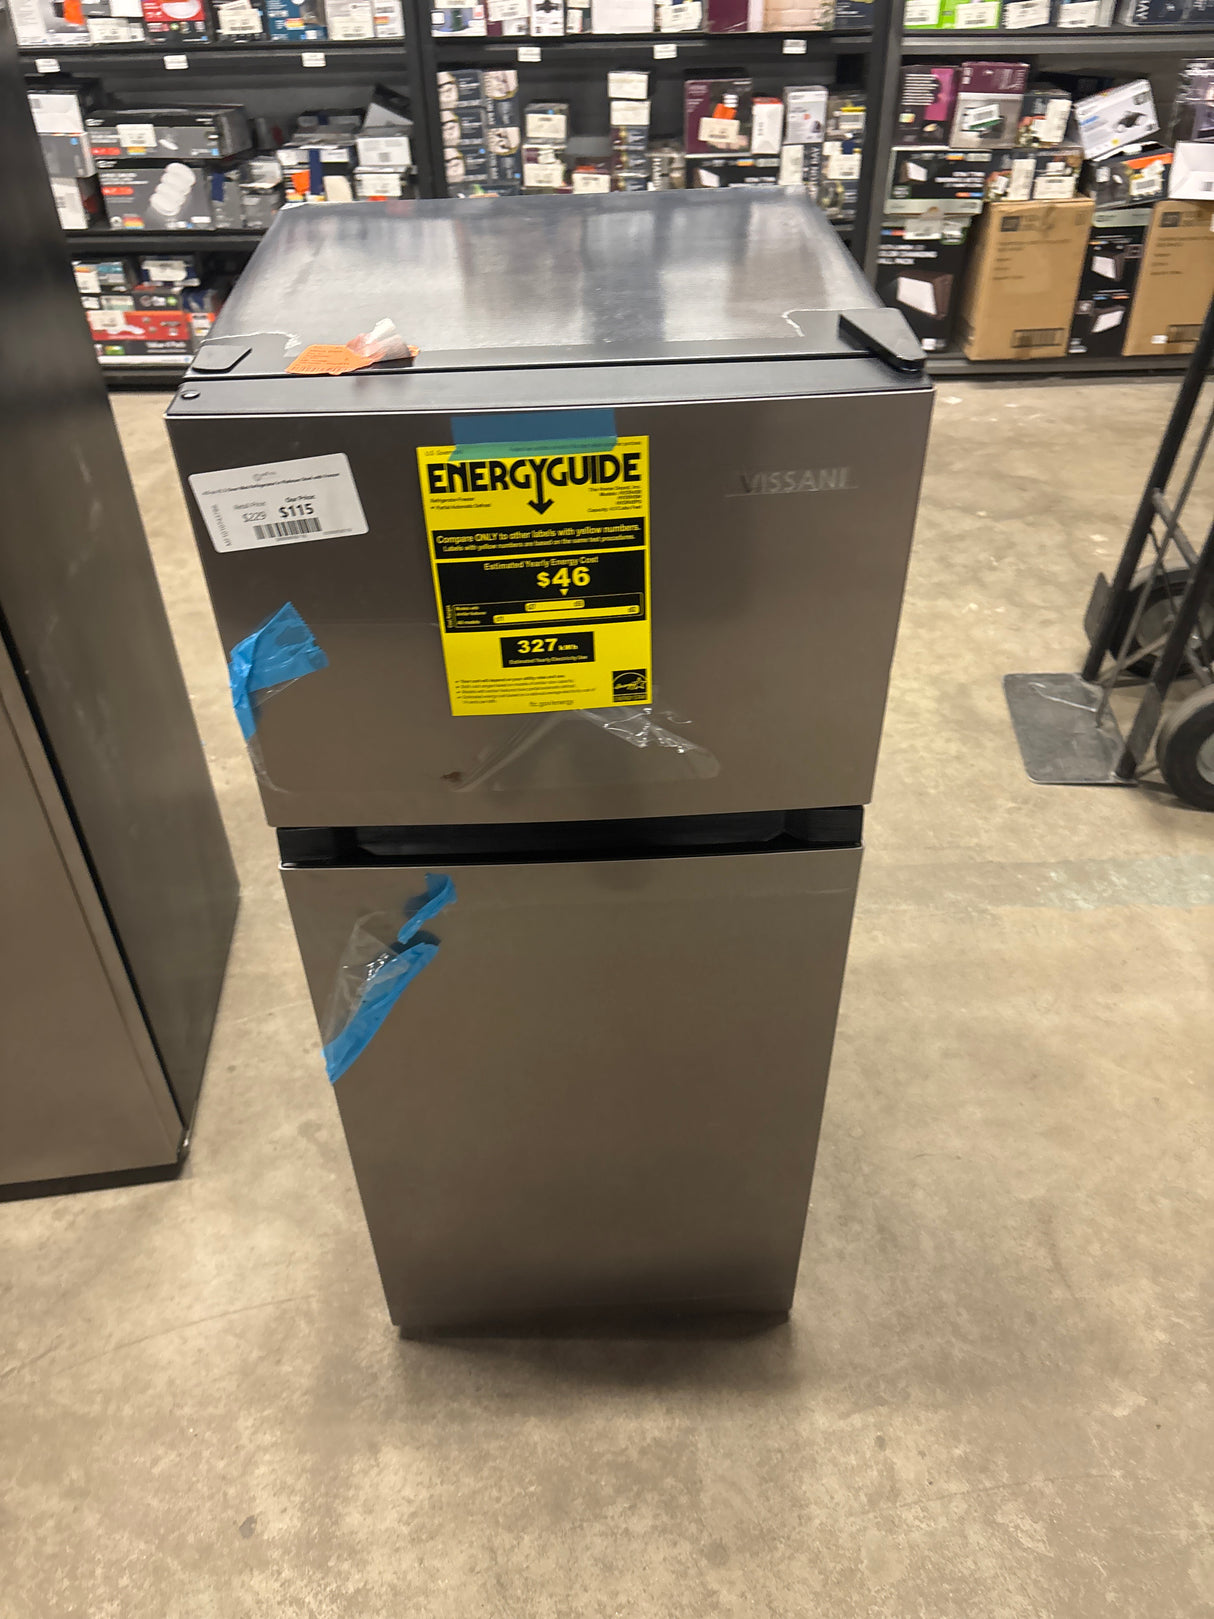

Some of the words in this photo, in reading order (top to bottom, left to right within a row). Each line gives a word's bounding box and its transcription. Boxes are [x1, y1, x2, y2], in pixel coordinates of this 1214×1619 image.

[426, 452, 642, 495] ENERGYGUIDE
[740, 466, 850, 494] VISSANI
[278, 503, 315, 518] $115
[436, 535, 474, 545] Compare
[474, 532, 498, 542] ONLY
[498, 532, 508, 540] to
[509, 530, 531, 540] other
[531, 529, 557, 538] labels
[557, 527, 575, 536] with
[575, 526, 602, 537] yellow
[602, 523, 641, 534] numbers.
[483, 560, 524, 571] Estimated
[525, 558, 549, 569] Yearly
[549, 557, 578, 567] Energy
[579, 556, 599, 564] Cost
[537, 566, 591, 588] $46
[517, 637, 558, 654] 327
